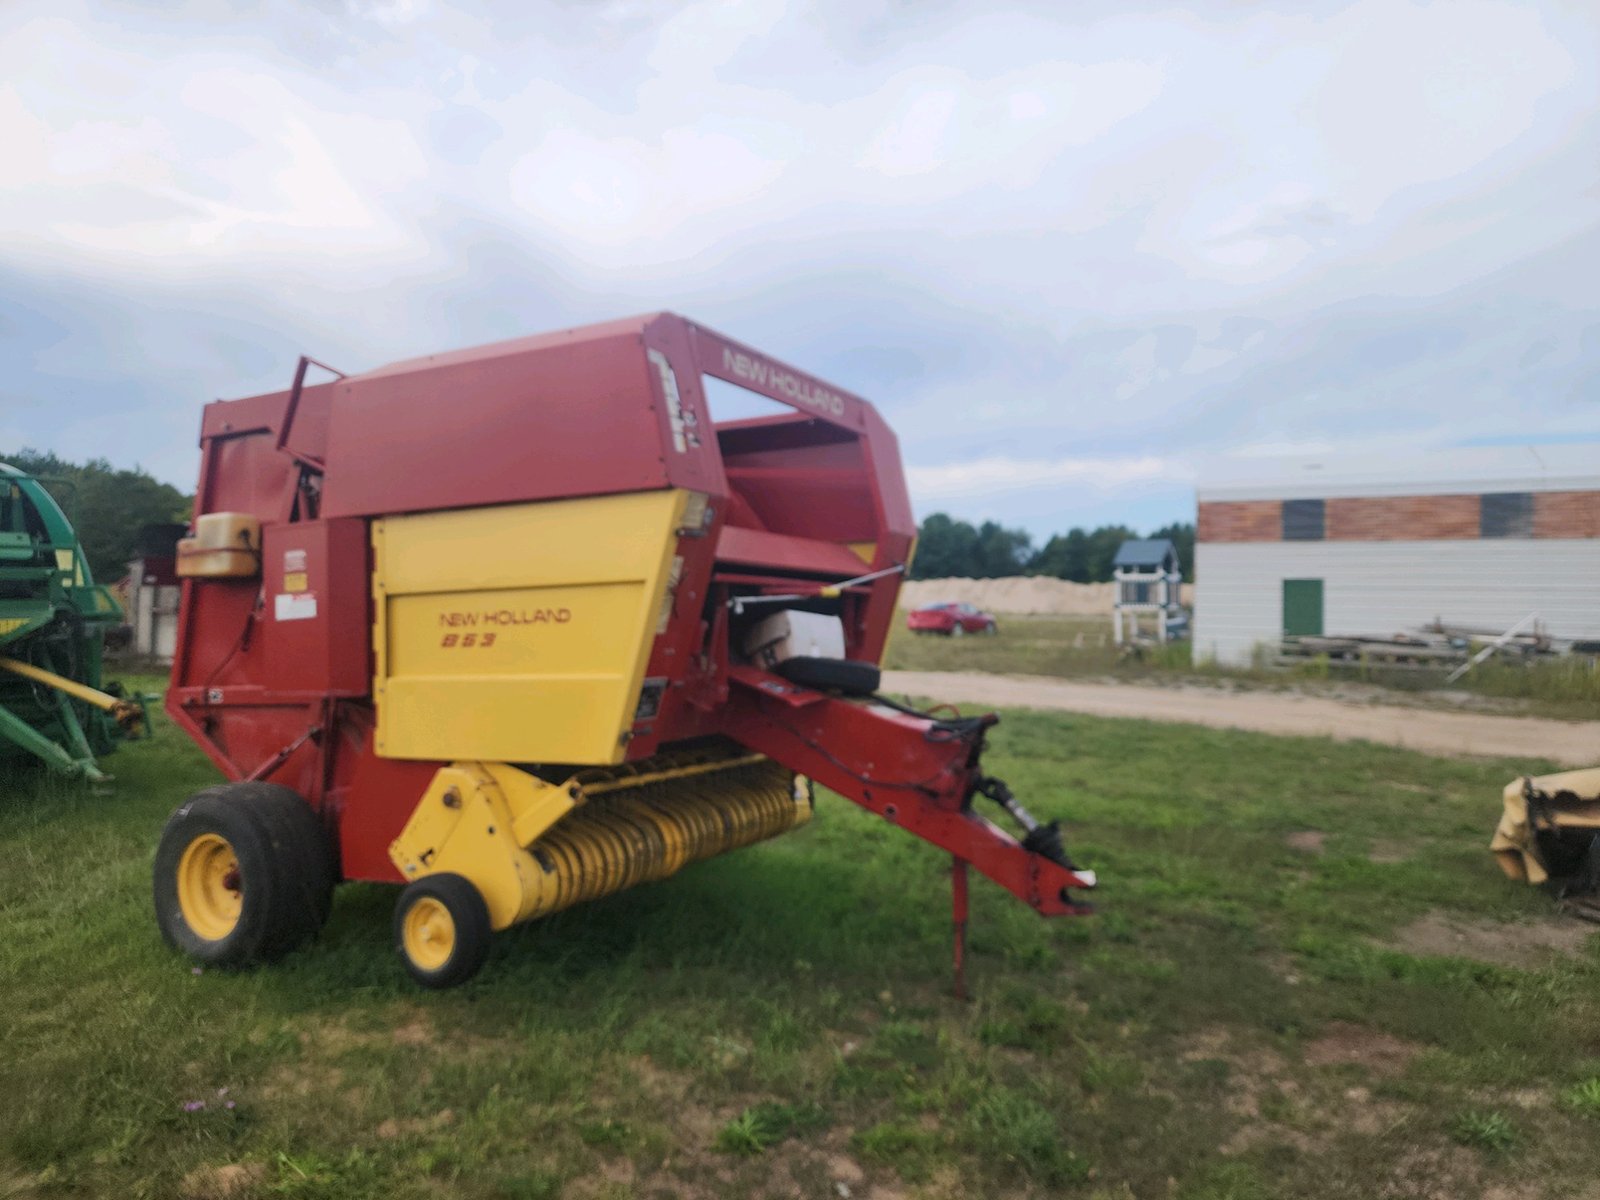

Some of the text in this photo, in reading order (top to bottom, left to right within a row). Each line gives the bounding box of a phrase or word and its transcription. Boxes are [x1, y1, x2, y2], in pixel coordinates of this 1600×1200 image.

[722, 348, 844, 416] NEW HOLLAND
[440, 608, 572, 627] NEW HOLLAND
